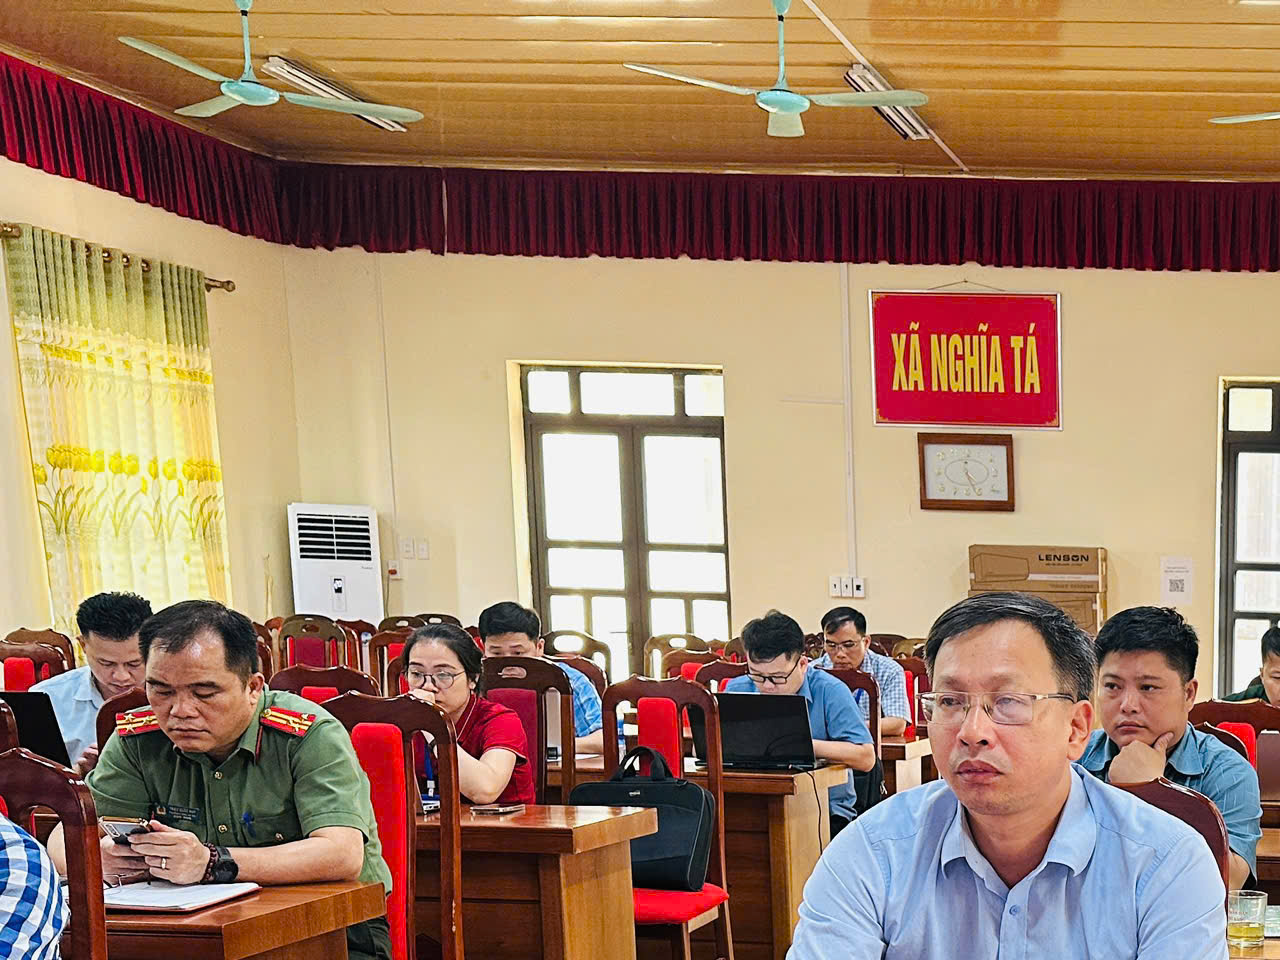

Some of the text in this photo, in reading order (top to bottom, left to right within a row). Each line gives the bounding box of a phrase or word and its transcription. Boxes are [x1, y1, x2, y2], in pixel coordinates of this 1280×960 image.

[891, 321, 1041, 394] XÃ NGHĨA TÁ
[1038, 554, 1089, 562] LENSON
